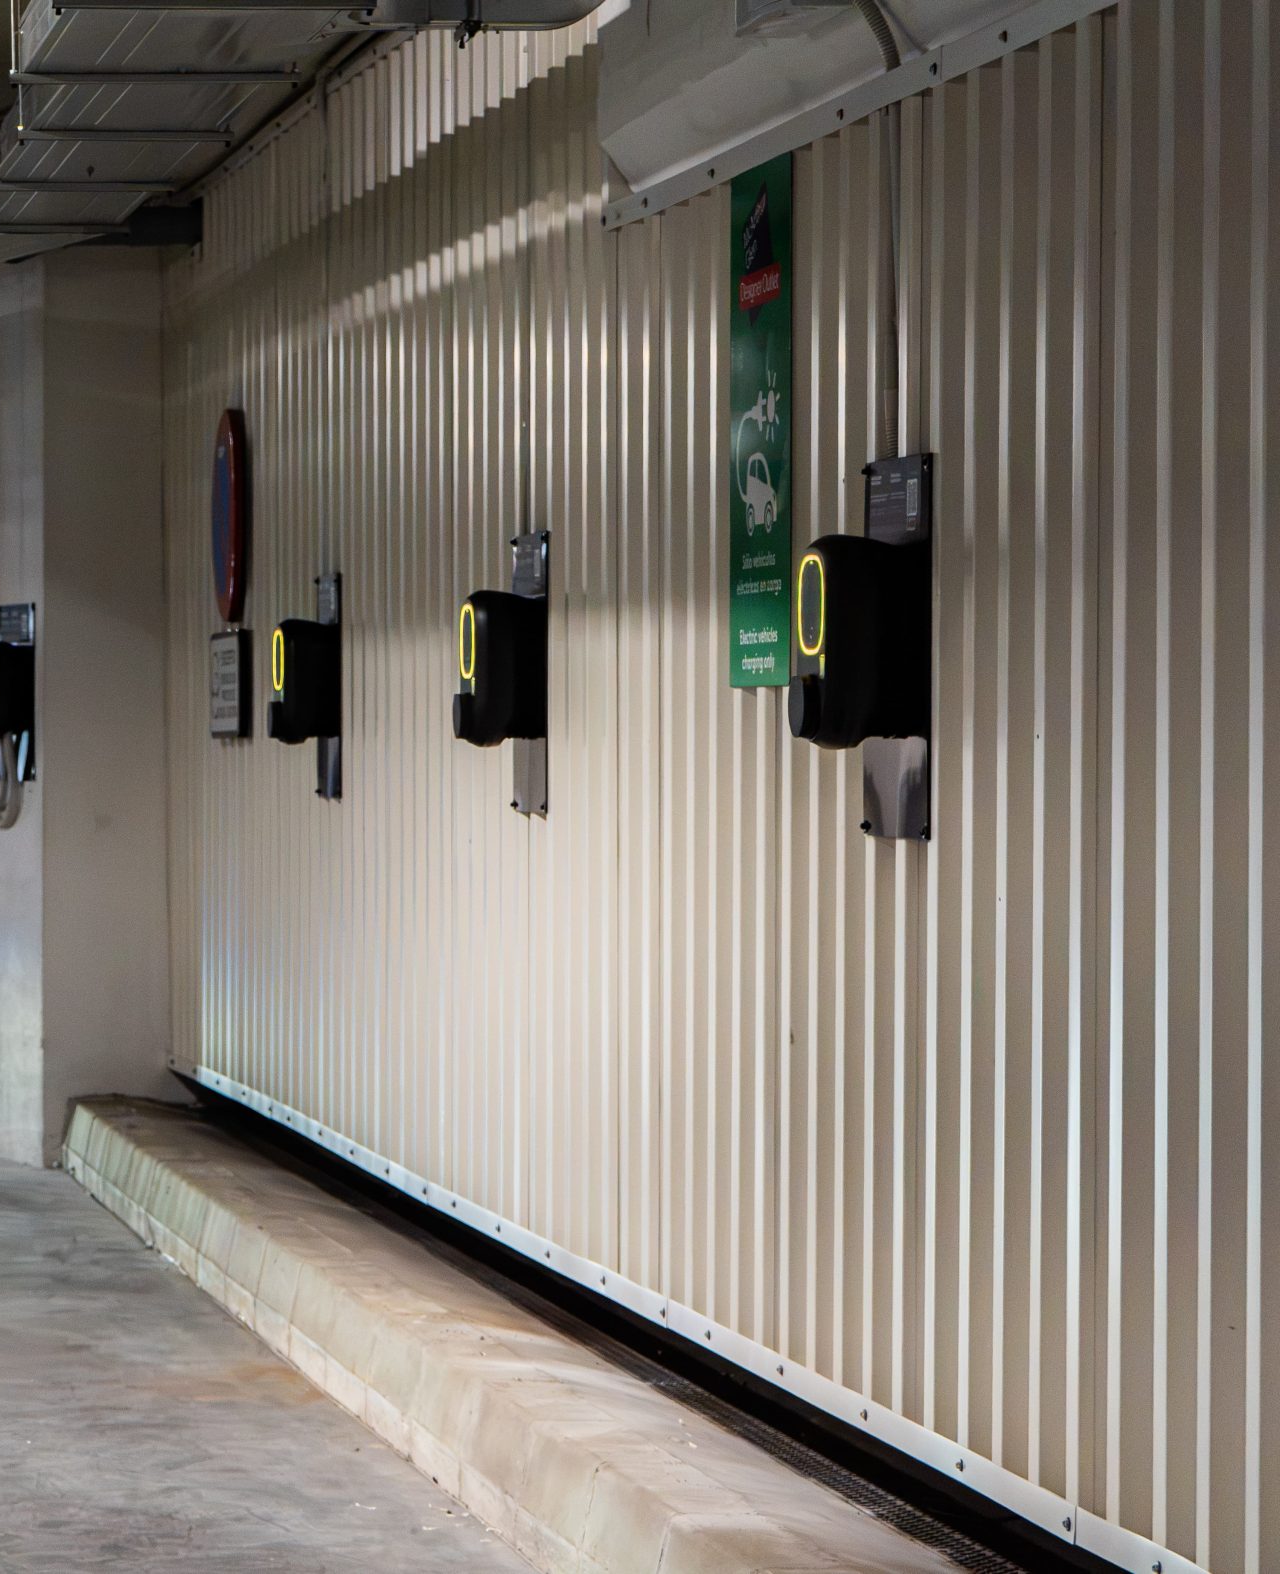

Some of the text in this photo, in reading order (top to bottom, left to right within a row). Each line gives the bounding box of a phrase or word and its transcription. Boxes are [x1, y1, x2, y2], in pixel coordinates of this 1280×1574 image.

[739, 273, 779, 303] Designer Outlet
[739, 627, 778, 645] Electric vehicles
[741, 652, 775, 674] charging only
